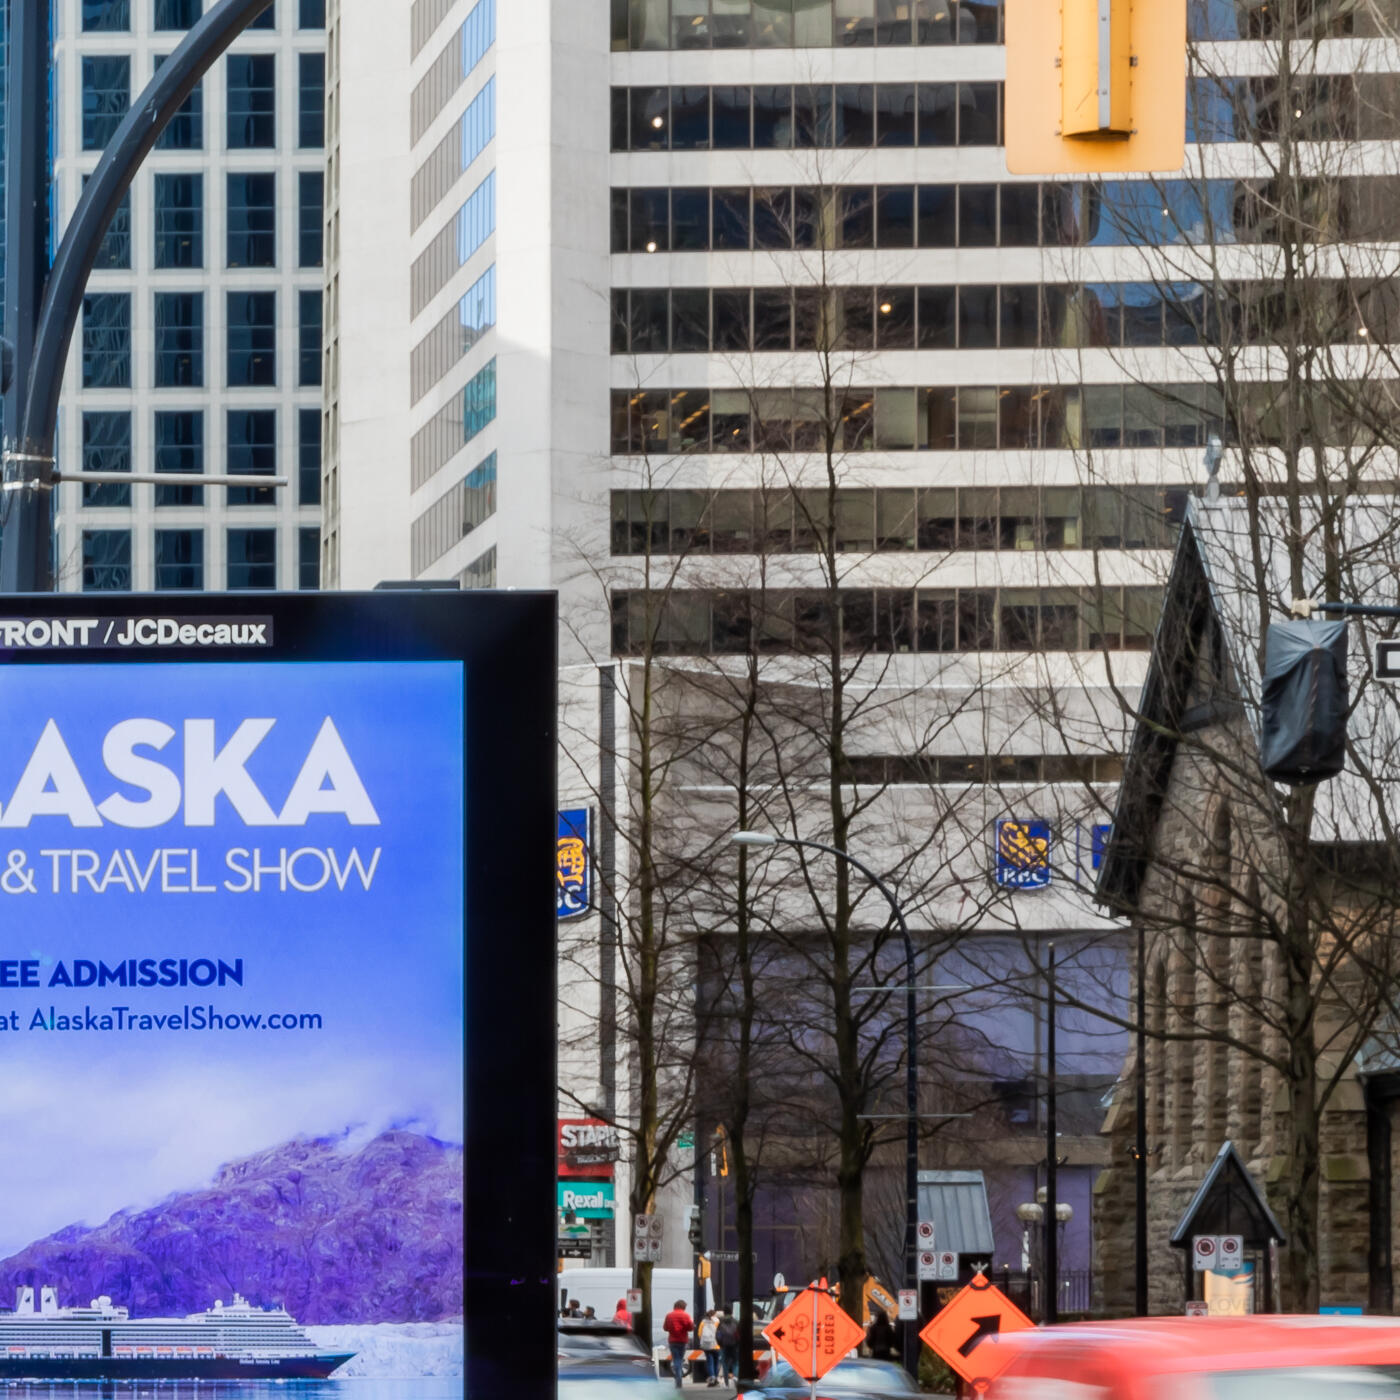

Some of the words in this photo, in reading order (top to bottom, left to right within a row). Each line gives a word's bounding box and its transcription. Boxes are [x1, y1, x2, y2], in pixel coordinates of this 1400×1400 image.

[1, 850, 36, 893] &
[41, 849, 215, 892] TRAVEL
[225, 847, 381, 891] SHOW
[48, 957, 244, 988] ADMISSION
[28, 1005, 323, 1031] AlaskaTravelShow.com
[563, 1190, 604, 1209] Rexall
[824, 1314, 836, 1355] CLOSED
